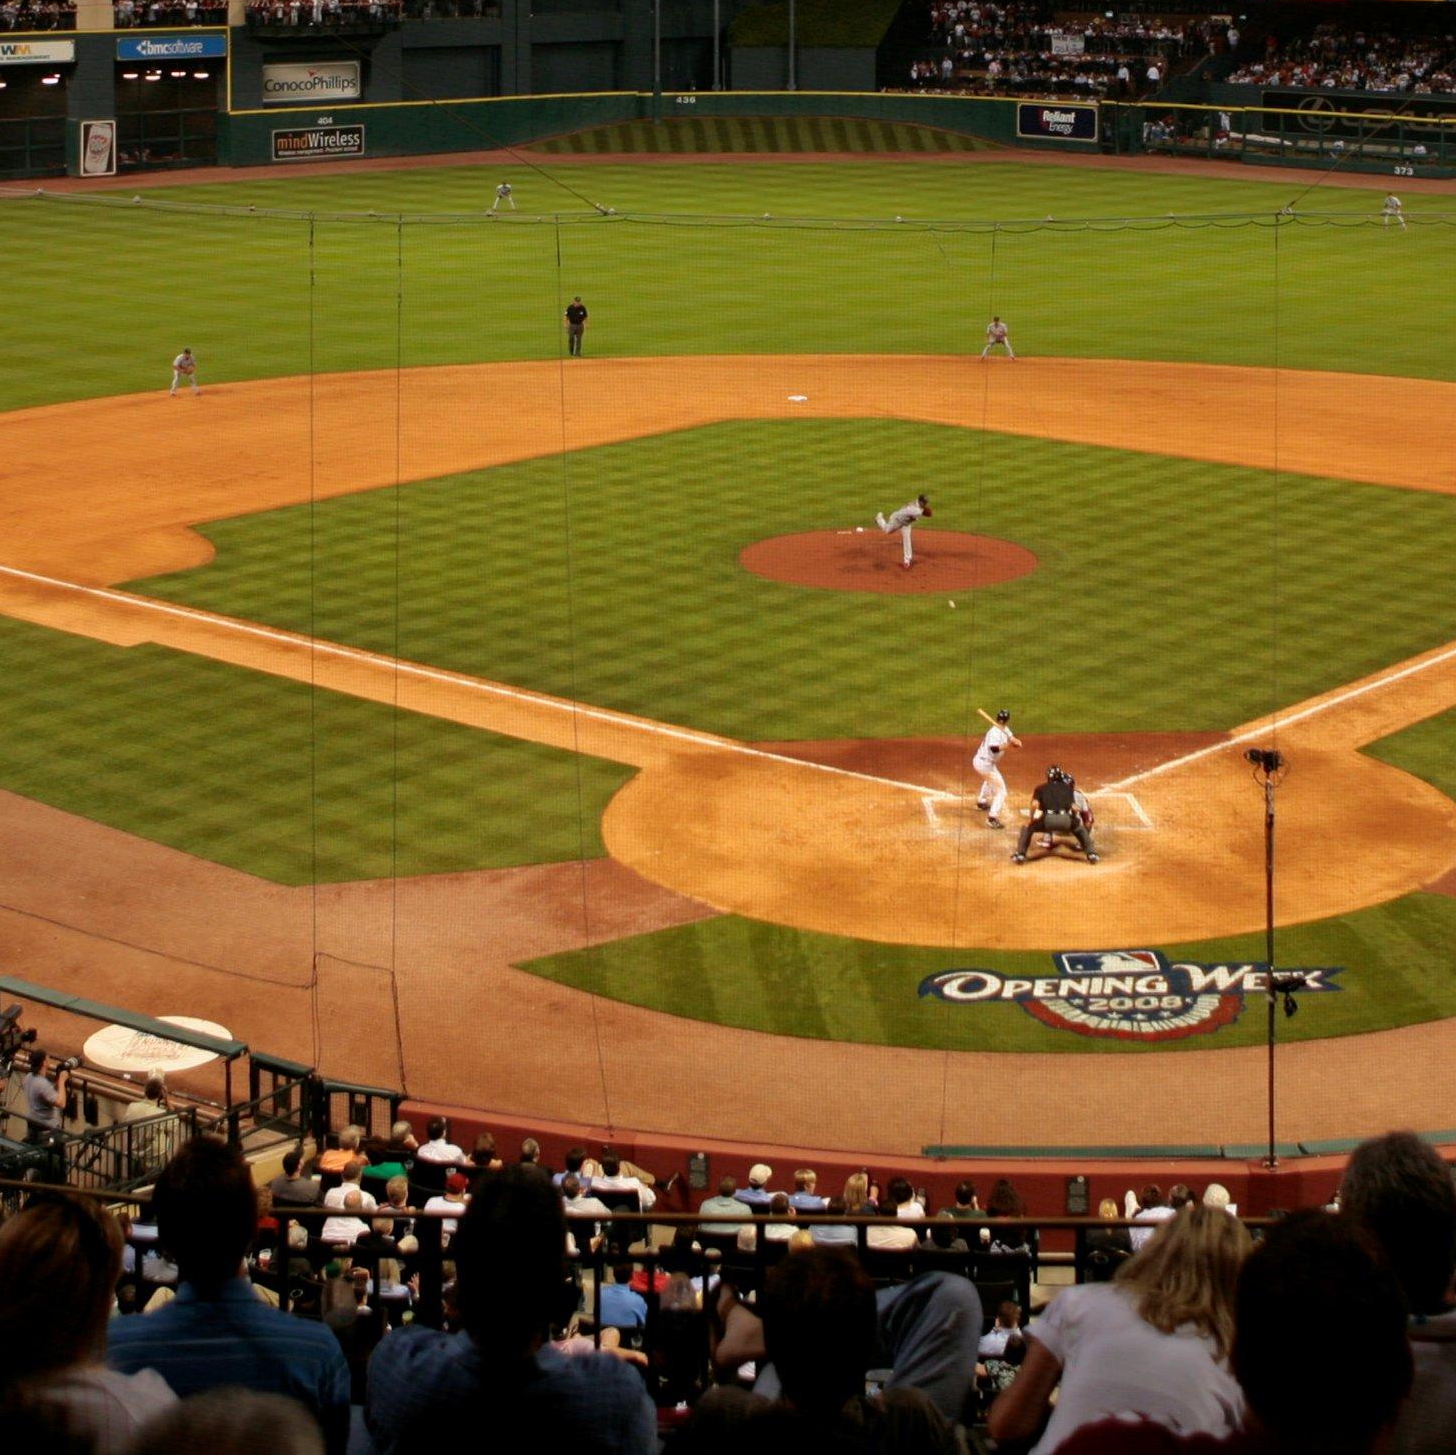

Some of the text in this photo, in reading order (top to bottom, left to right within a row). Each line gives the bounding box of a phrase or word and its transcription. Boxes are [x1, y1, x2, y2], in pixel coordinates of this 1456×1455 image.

[264, 76, 357, 94] ConocoPhillips
[1043, 109, 1076, 125] Reliant
[1048, 123, 1075, 135] Energy
[276, 129, 361, 150] mindWireless
[1393, 165, 1414, 176] 373
[933, 962, 1326, 1001] OPENING WEK
[1088, 995, 1187, 1013] 2008
